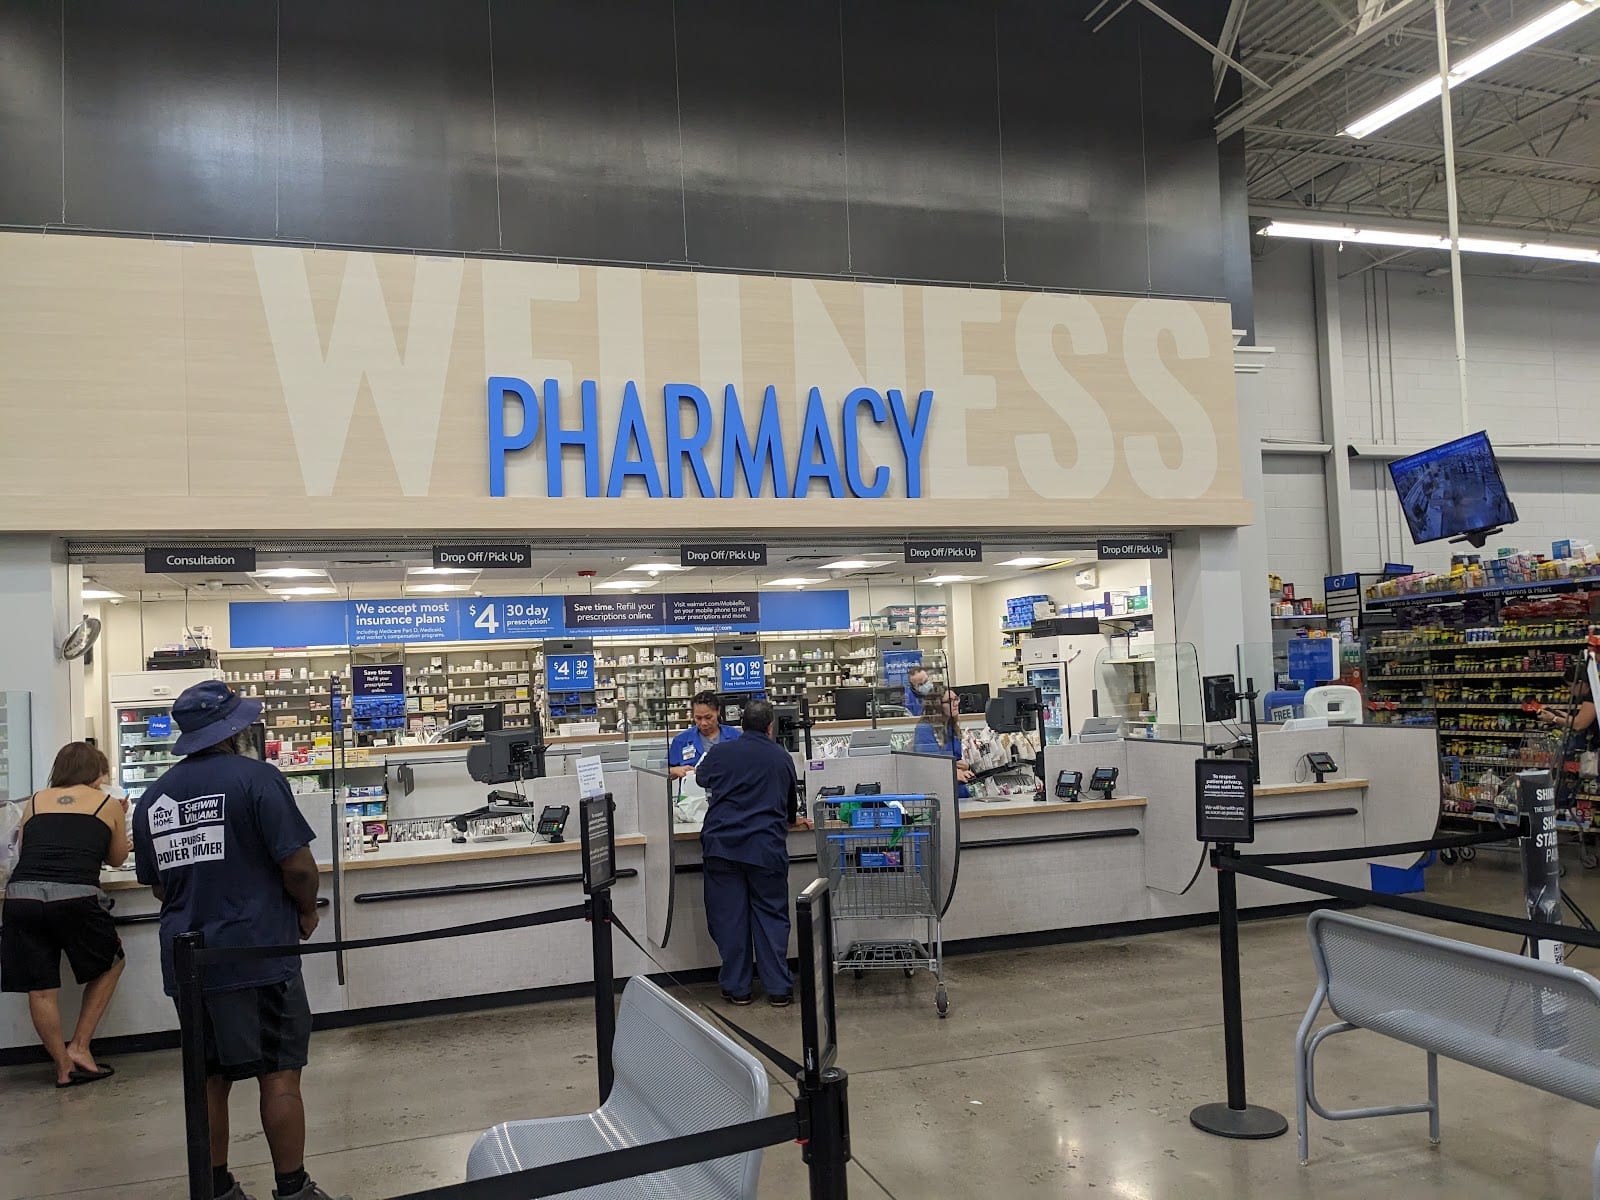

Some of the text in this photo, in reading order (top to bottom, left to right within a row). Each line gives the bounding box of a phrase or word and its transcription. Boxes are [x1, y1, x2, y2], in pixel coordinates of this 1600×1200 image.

[488, 376, 934, 498] PHARMACY
[687, 550, 761, 562] Drop Off/Pick Up
[910, 548, 977, 558] Drop Off/Pick Up
[1102, 545, 1163, 555] Drop Off/Pick Up
[166, 555, 235, 566] Consultation
[440, 551, 524, 563] Drop Off/Pick Up
[355, 602, 450, 616] We accept most
[506, 603, 549, 619] 30 day
[574, 602, 656, 612] Save time. Refill your
[714, 606, 731, 614] phone
[356, 613, 446, 627] insurance plans
[469, 603, 500, 634] $4
[577, 612, 654, 623] prescriptions online.
[553, 660, 570, 676] $4
[576, 660, 588, 669] 30
[724, 662, 746, 677] $10
[749, 661, 760, 670] 90
[576, 668, 588, 677] day
[749, 669, 761, 677] day
[1273, 708, 1292, 721] FREE
[153, 809, 173, 821] HGTV
[153, 816, 174, 828] HOME
